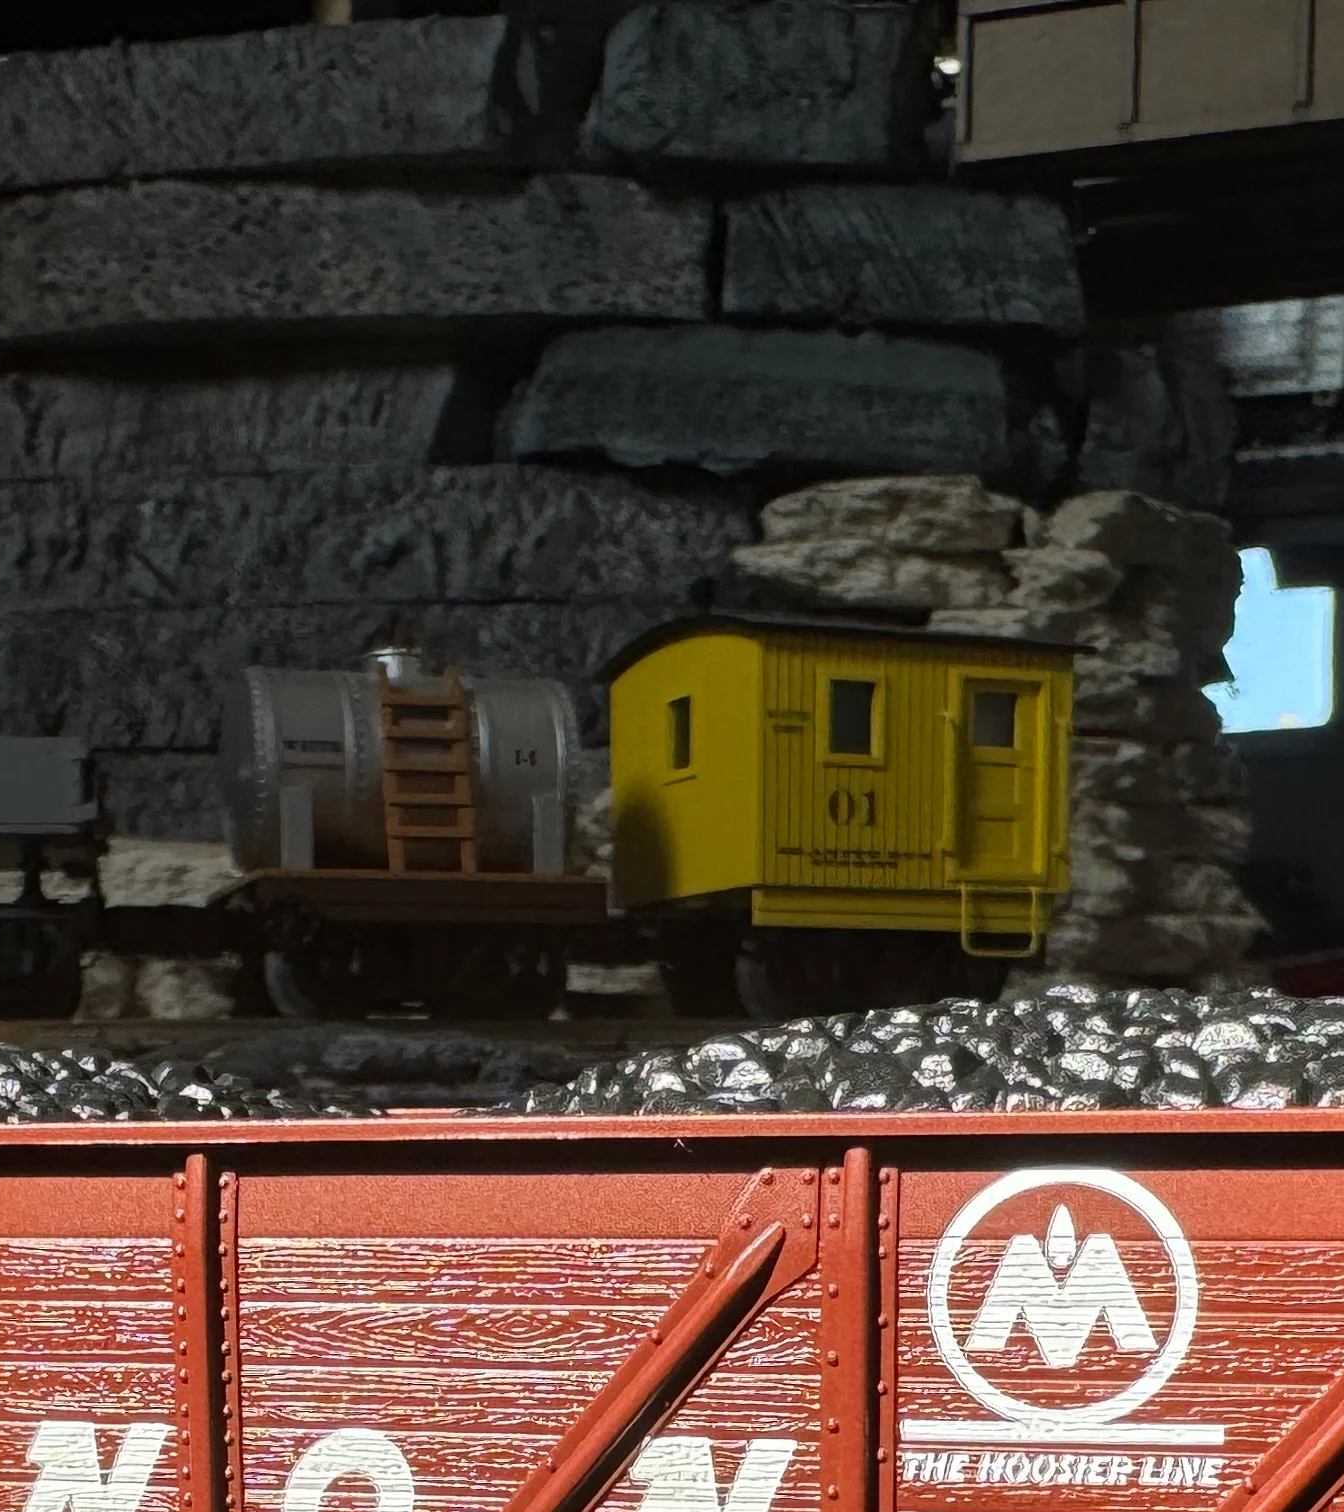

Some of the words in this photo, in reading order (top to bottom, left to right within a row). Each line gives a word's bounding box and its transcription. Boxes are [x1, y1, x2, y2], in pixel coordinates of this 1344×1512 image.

[903, 1452, 969, 1483] THE
[978, 1453, 1132, 1486] HOOSIER
[1139, 1457, 1226, 1487] LINE
